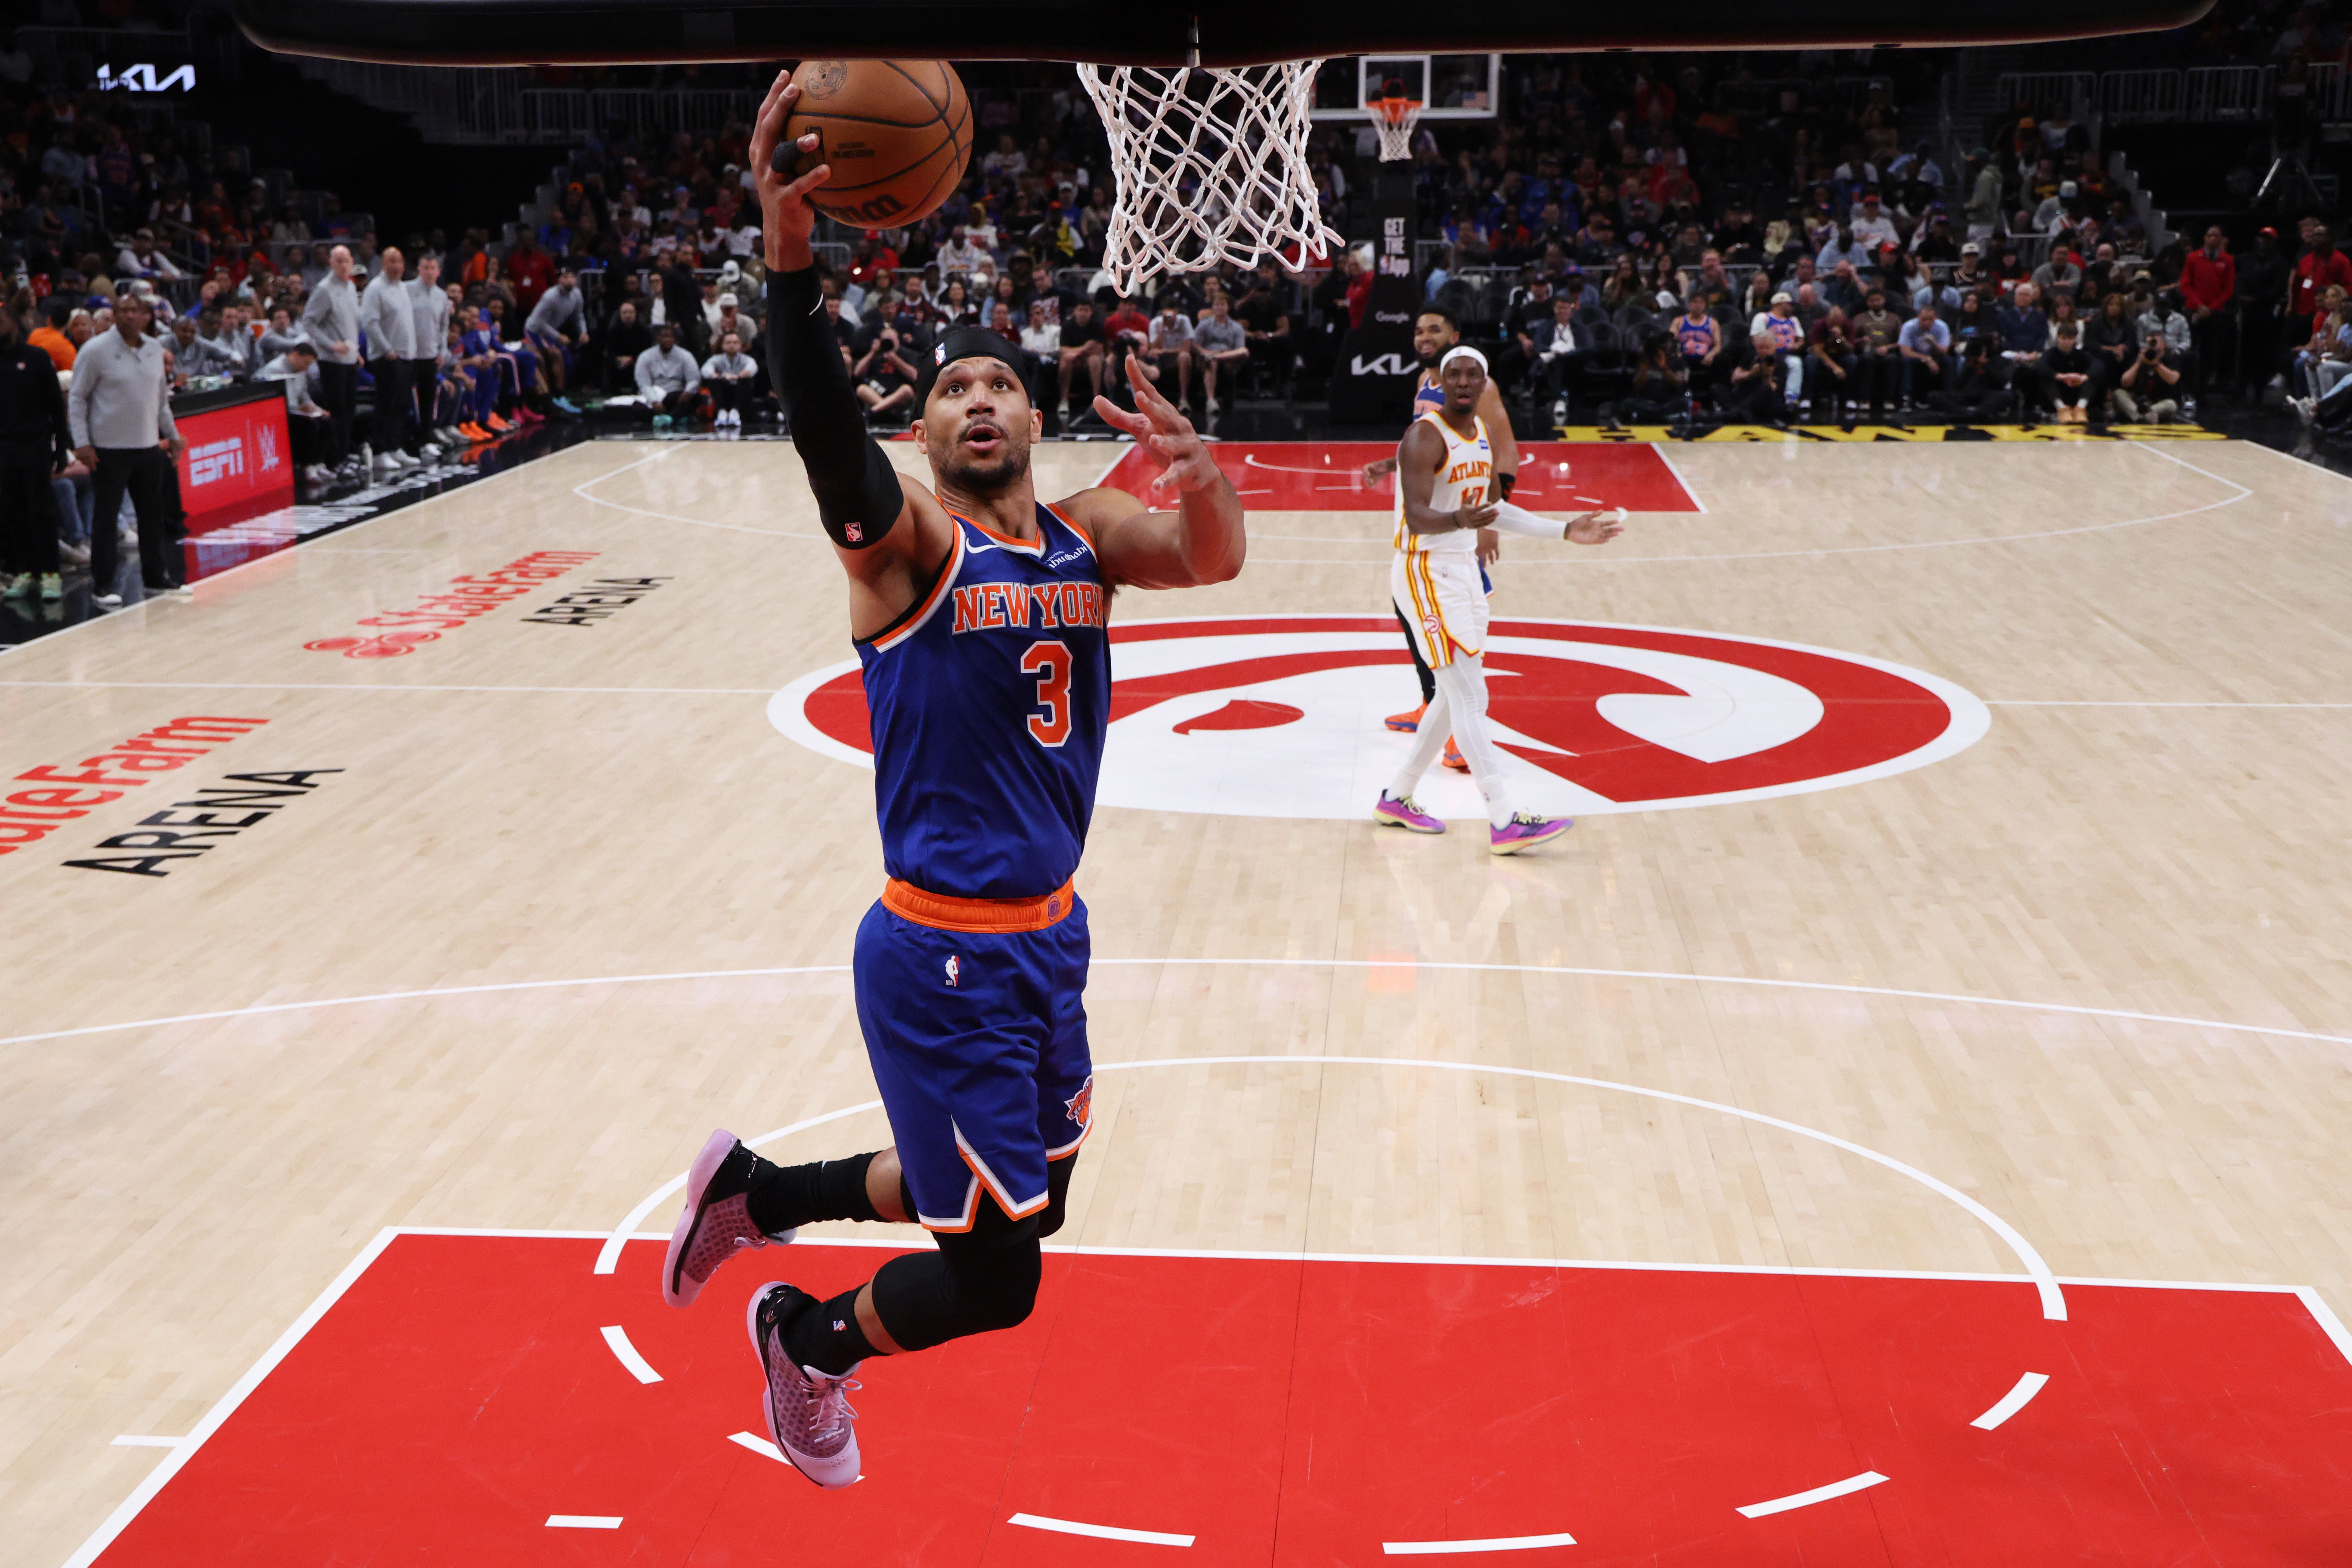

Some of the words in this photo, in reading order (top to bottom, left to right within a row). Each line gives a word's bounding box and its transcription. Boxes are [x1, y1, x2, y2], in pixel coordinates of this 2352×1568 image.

[1384, 217, 1406, 236] GET
[1384, 236, 1406, 255] THE
[1375, 310, 1410, 324] Google
[1552, 425, 2228, 443] HAWKS
[188, 437, 244, 486] ESPN
[1447, 461, 1491, 484] ATLANT
[520, 576, 674, 627] ARENA
[951, 582, 1030, 635] NEW
[1020, 640, 1073, 748] 3
[0, 716, 270, 856] ateFarm
[61, 768, 346, 877] ARENA
